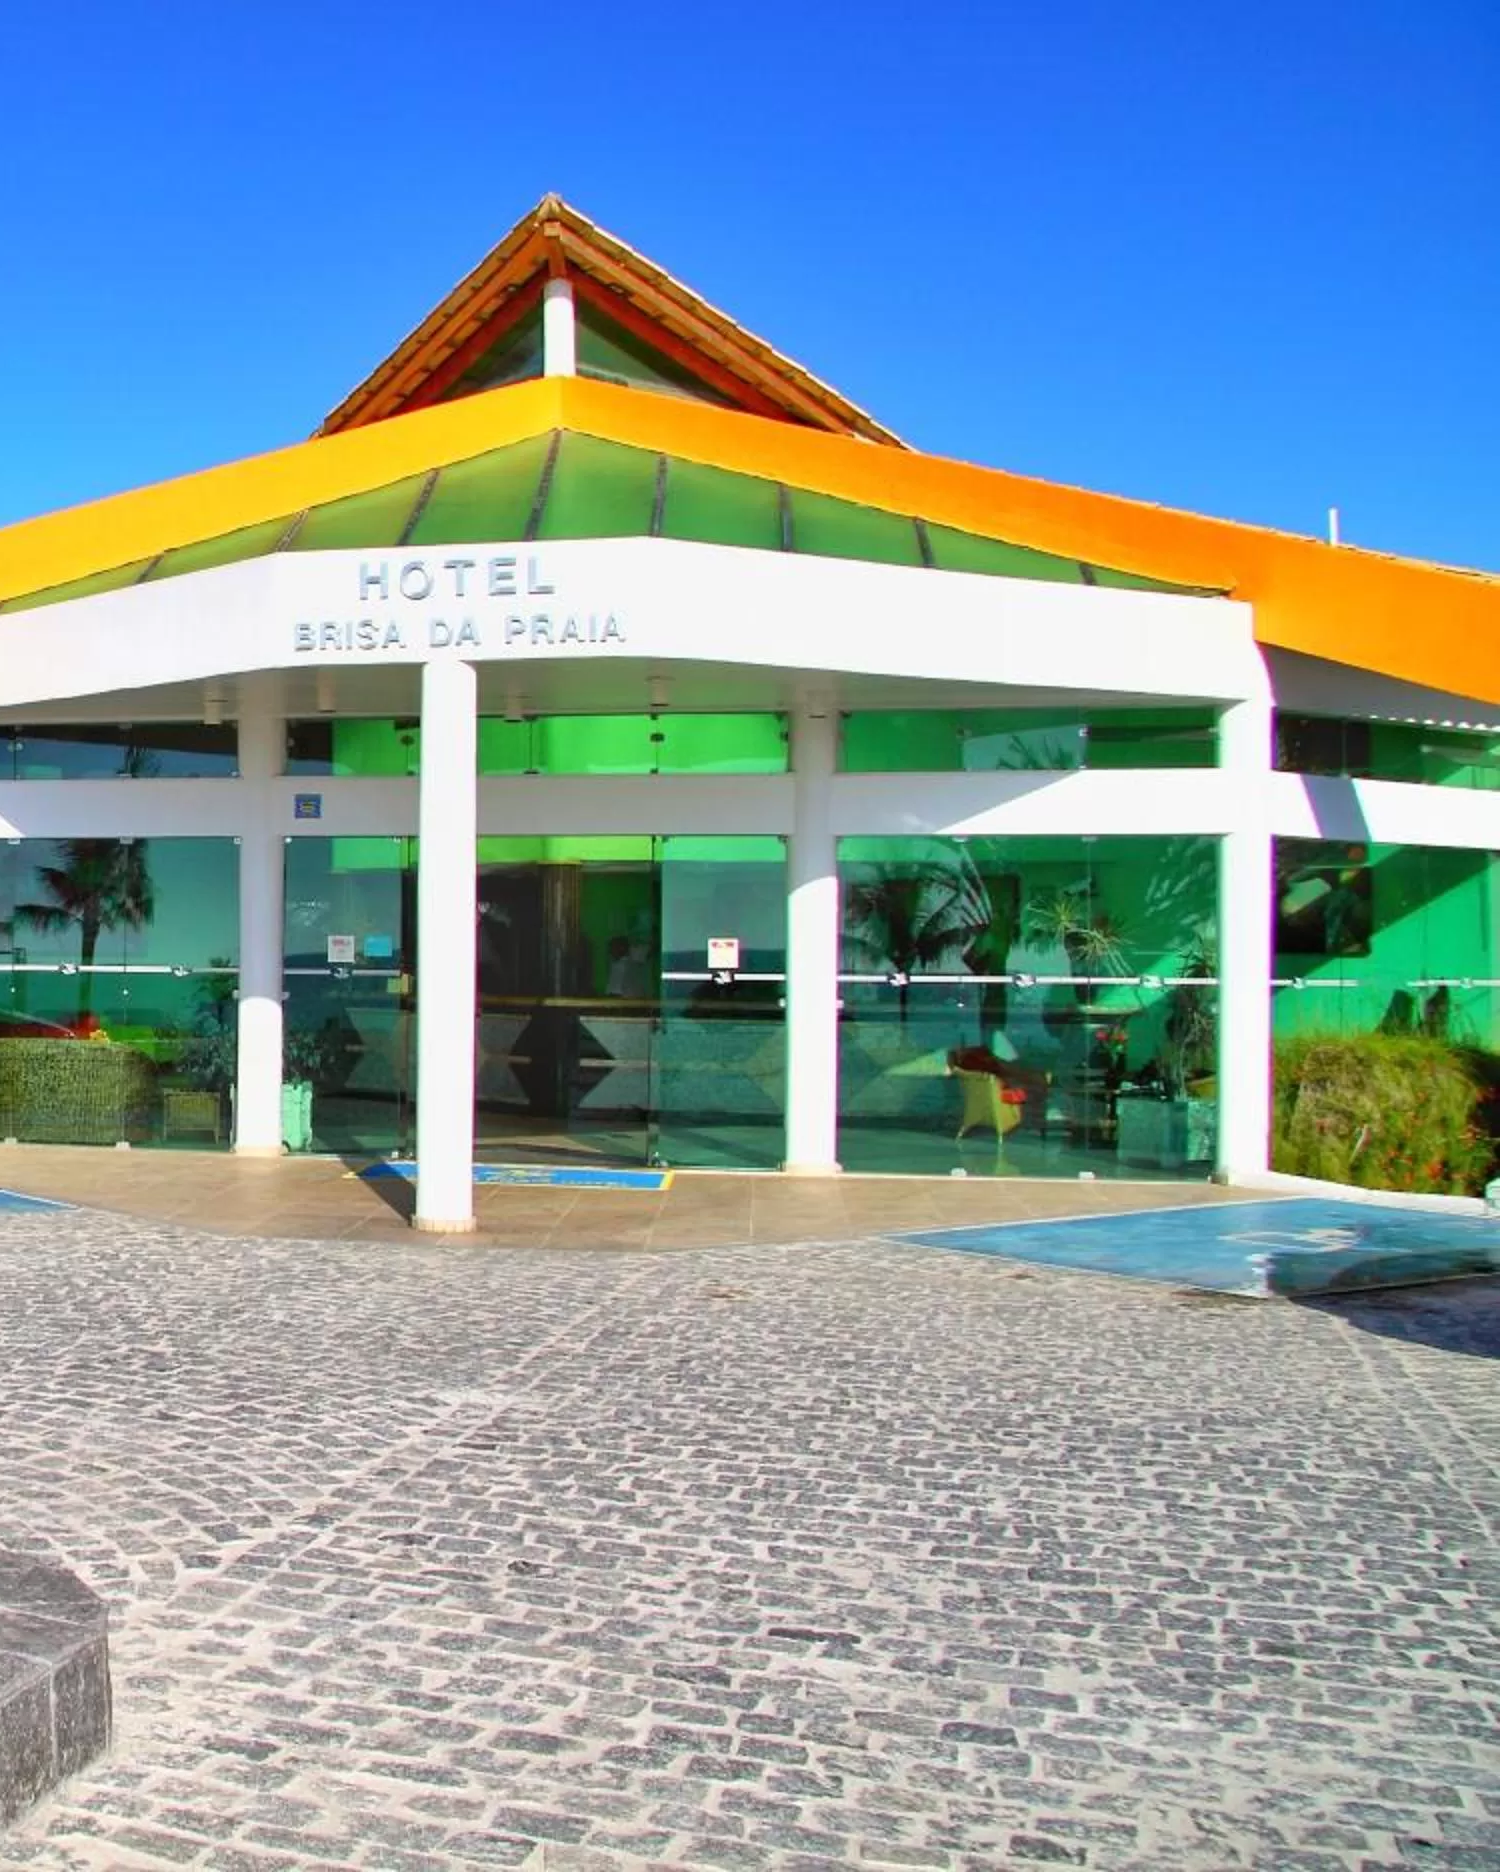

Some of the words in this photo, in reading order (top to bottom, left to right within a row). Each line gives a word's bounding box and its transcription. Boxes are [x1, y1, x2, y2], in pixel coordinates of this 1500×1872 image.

[358, 556, 555, 600] HOTEL
[294, 619, 406, 652] BRISA
[429, 617, 481, 648] DA
[505, 612, 626, 646] PRAIA
